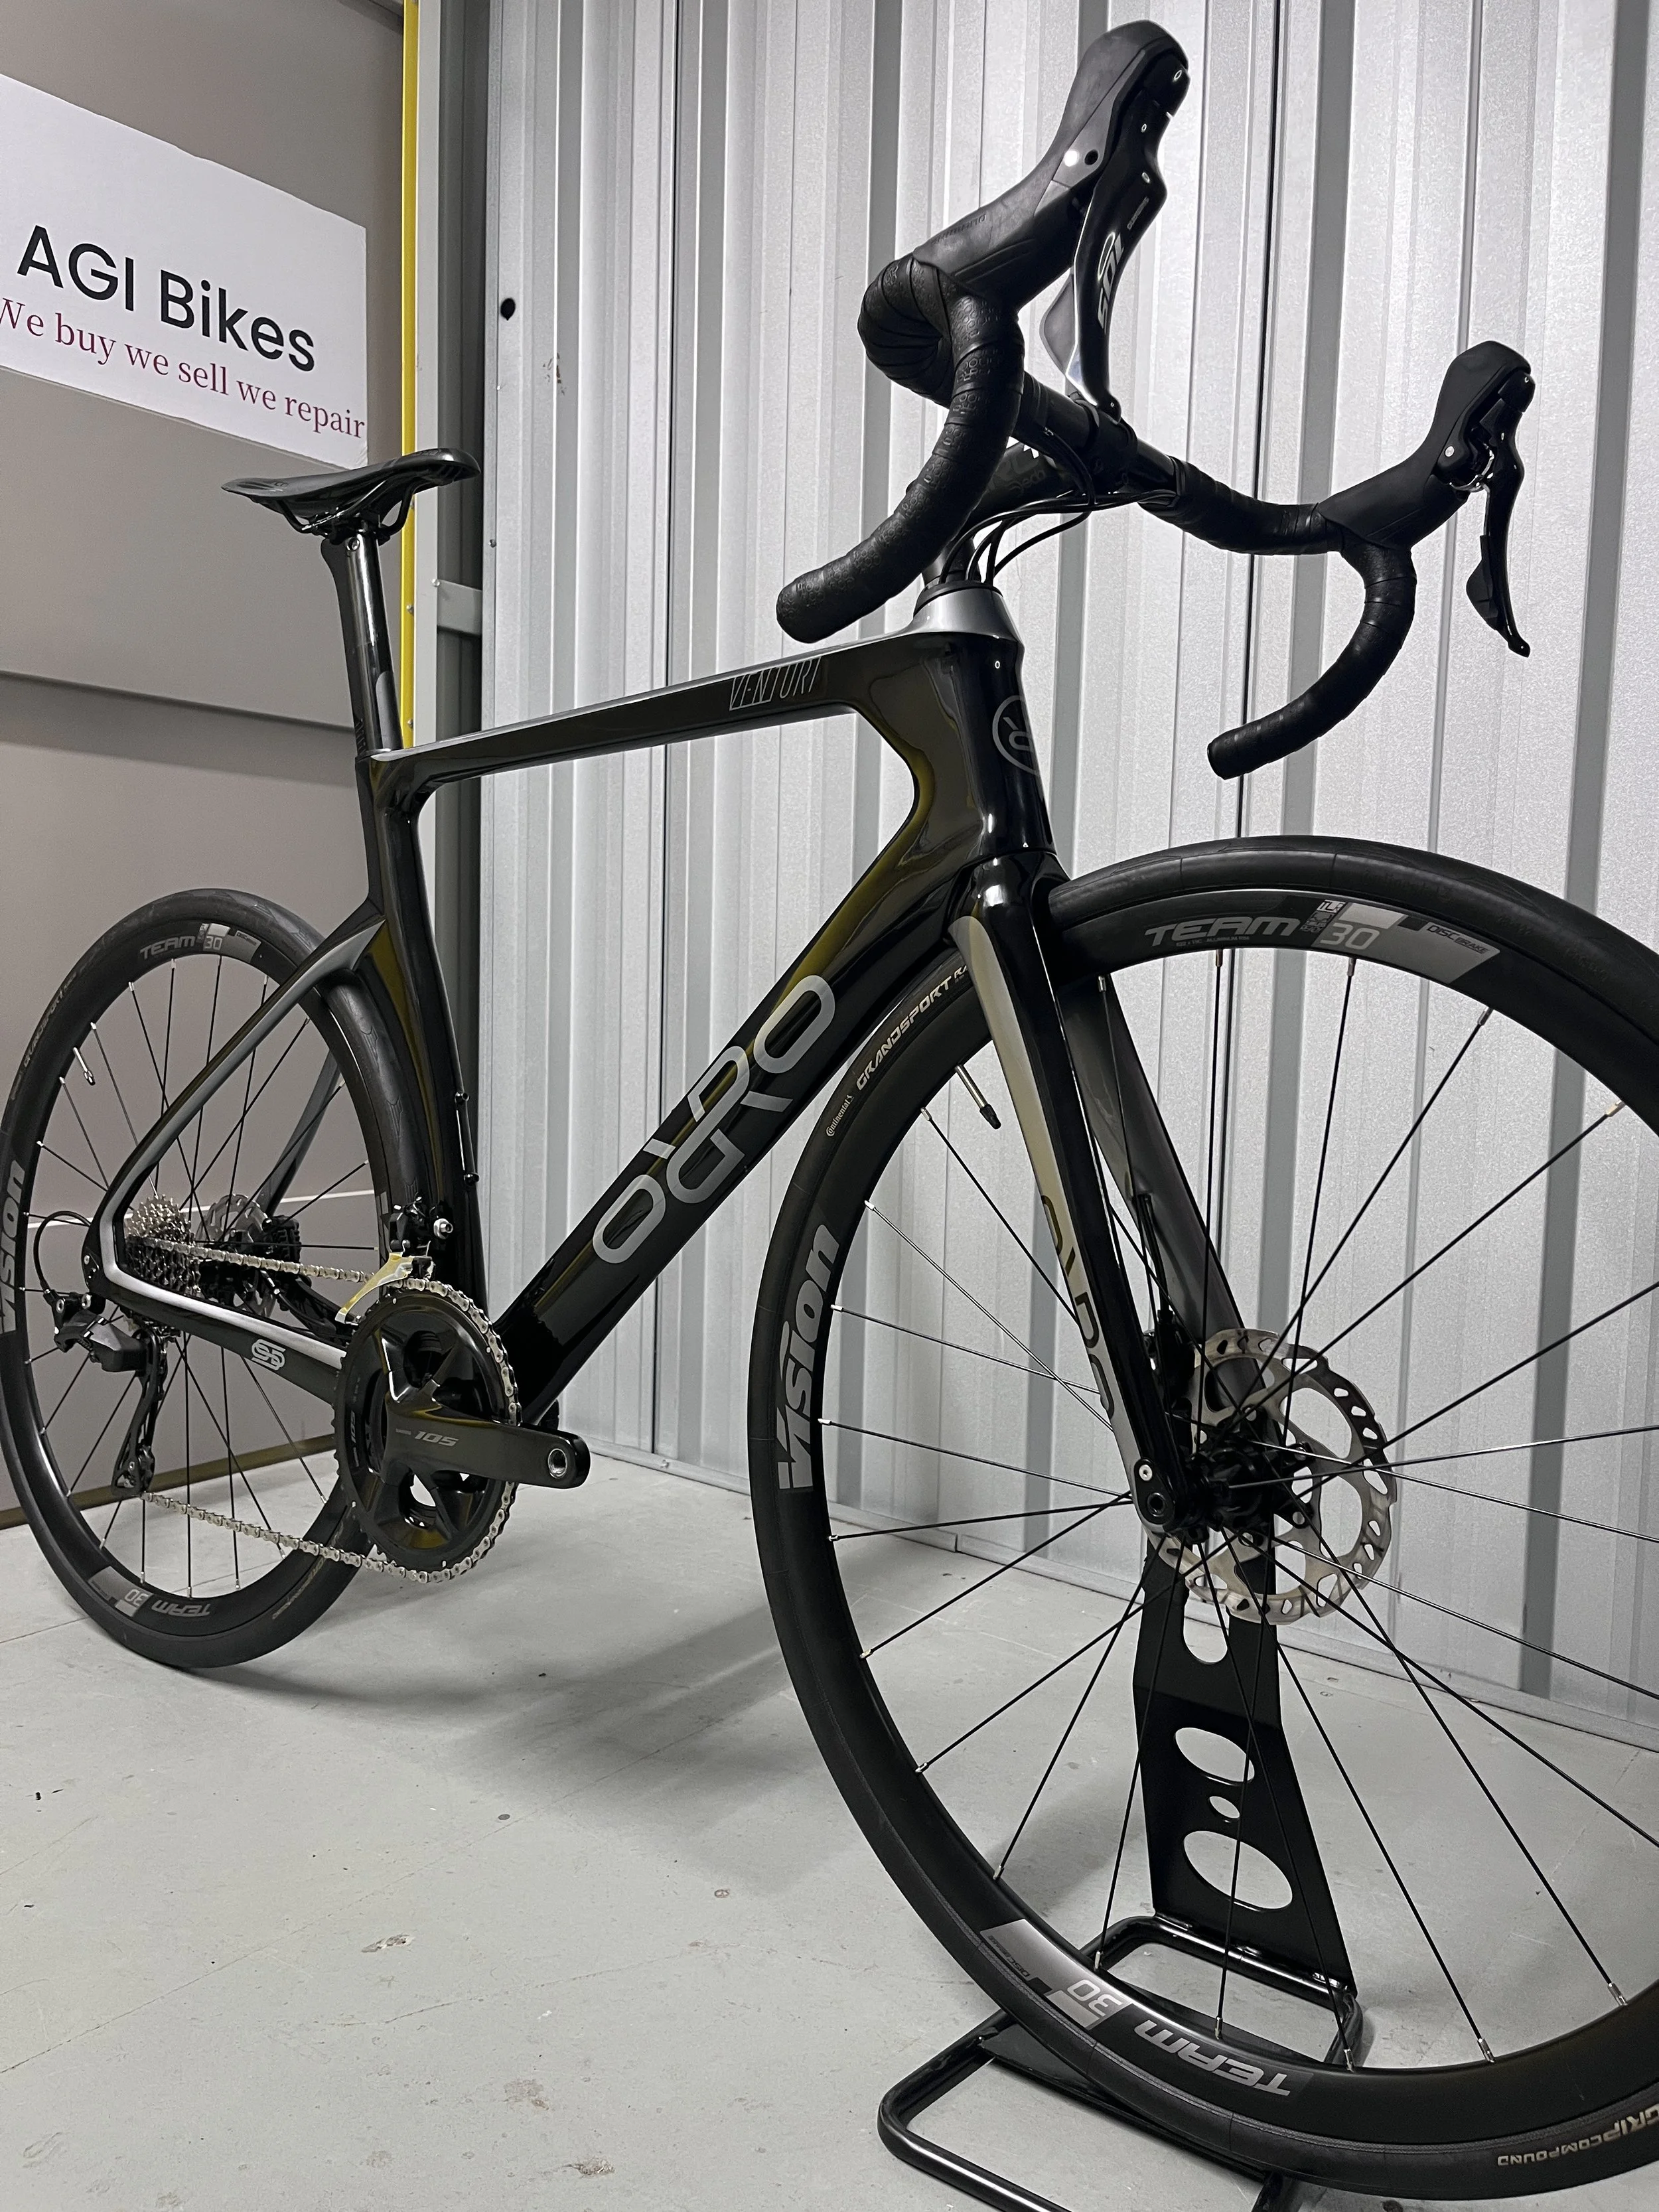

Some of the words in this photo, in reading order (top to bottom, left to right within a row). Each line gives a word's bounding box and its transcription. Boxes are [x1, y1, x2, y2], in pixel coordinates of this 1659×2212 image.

[17, 225, 134, 312] AGI
[161, 269, 315, 372] Bikes
[0, 297, 44, 337] We
[55, 313, 117, 365] buy
[125, 344, 169, 376] we
[178, 363, 229, 396] sell
[236, 380, 277, 411] we
[285, 396, 366, 439] repair
[139, 935, 196, 960] TEAM
[204, 935, 223, 951] 30
[1145, 916, 1301, 947] TEAM
[1319, 922, 1380, 950] 30
[1427, 924, 1461, 940] DISC
[413, 1430, 460, 1447] 105
[151, 1599, 211, 1617] TEAM
[1067, 1978, 1123, 2018] 30
[1133, 2020, 1291, 2097] TEAM
